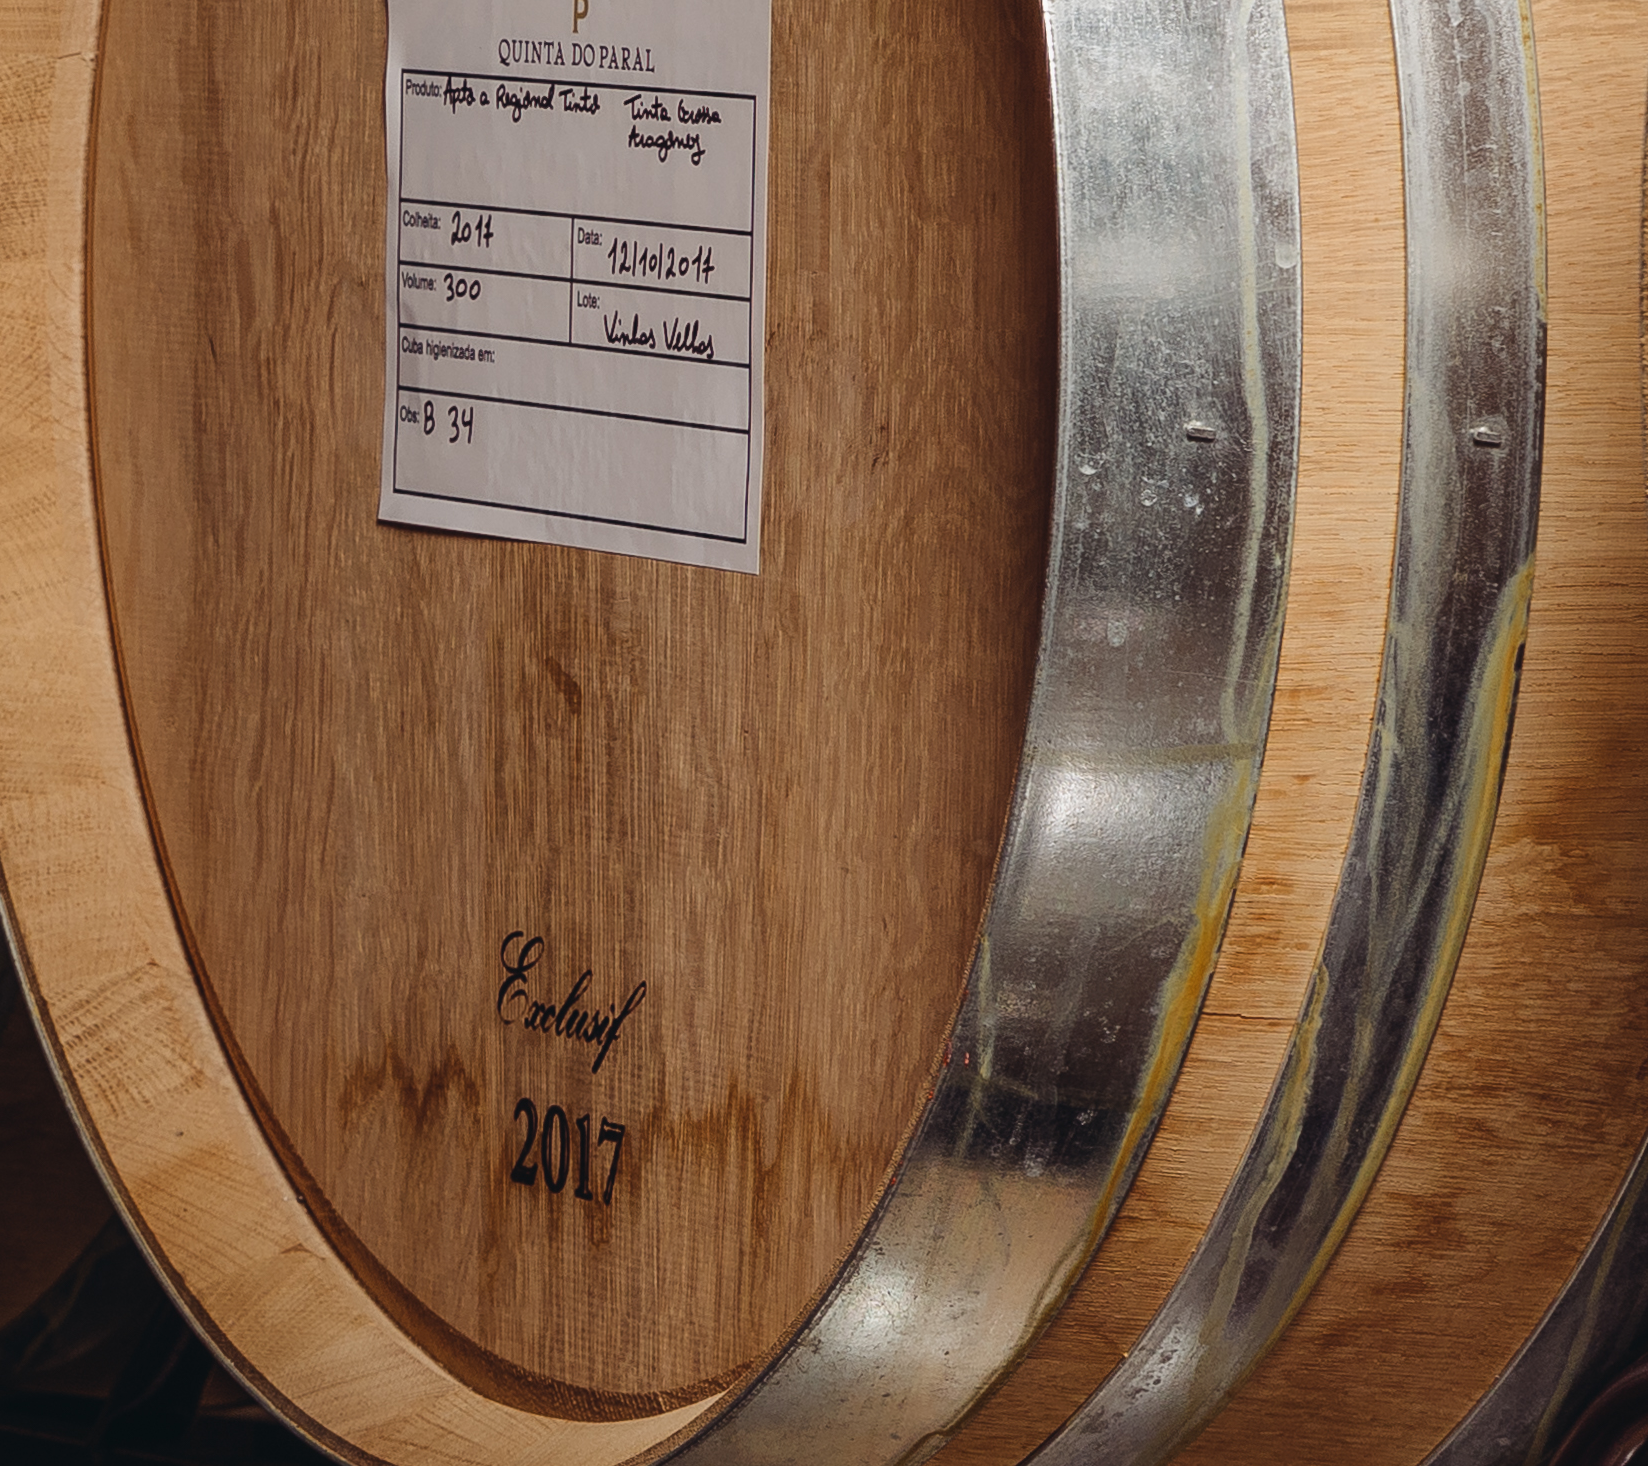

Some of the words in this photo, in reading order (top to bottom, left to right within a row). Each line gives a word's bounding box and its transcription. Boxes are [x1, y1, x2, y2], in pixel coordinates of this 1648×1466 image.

[498, 38, 565, 67] QUINTA
[571, 42, 596, 68] DO
[599, 45, 656, 73] PARAL
[405, 79, 442, 98] Produto:
[496, 83, 556, 123] Regional
[559, 87, 601, 115] Tinto
[402, 210, 441, 230] Colheita:
[450, 210, 494, 248] 2017
[577, 227, 603, 247] Data:
[607, 237, 715, 285] 12/10/2017
[401, 272, 436, 292] Volume:
[443, 273, 481, 302] 300
[577, 291, 600, 310] Lote:
[401, 336, 423, 356] Cuba
[425, 339, 476, 361] higienizada
[478, 348, 495, 364] em:
[399, 404, 420, 424] Obs:
[423, 400, 435, 436] B
[448, 405, 474, 444] 34
[510, 1097, 627, 1206] 2017
